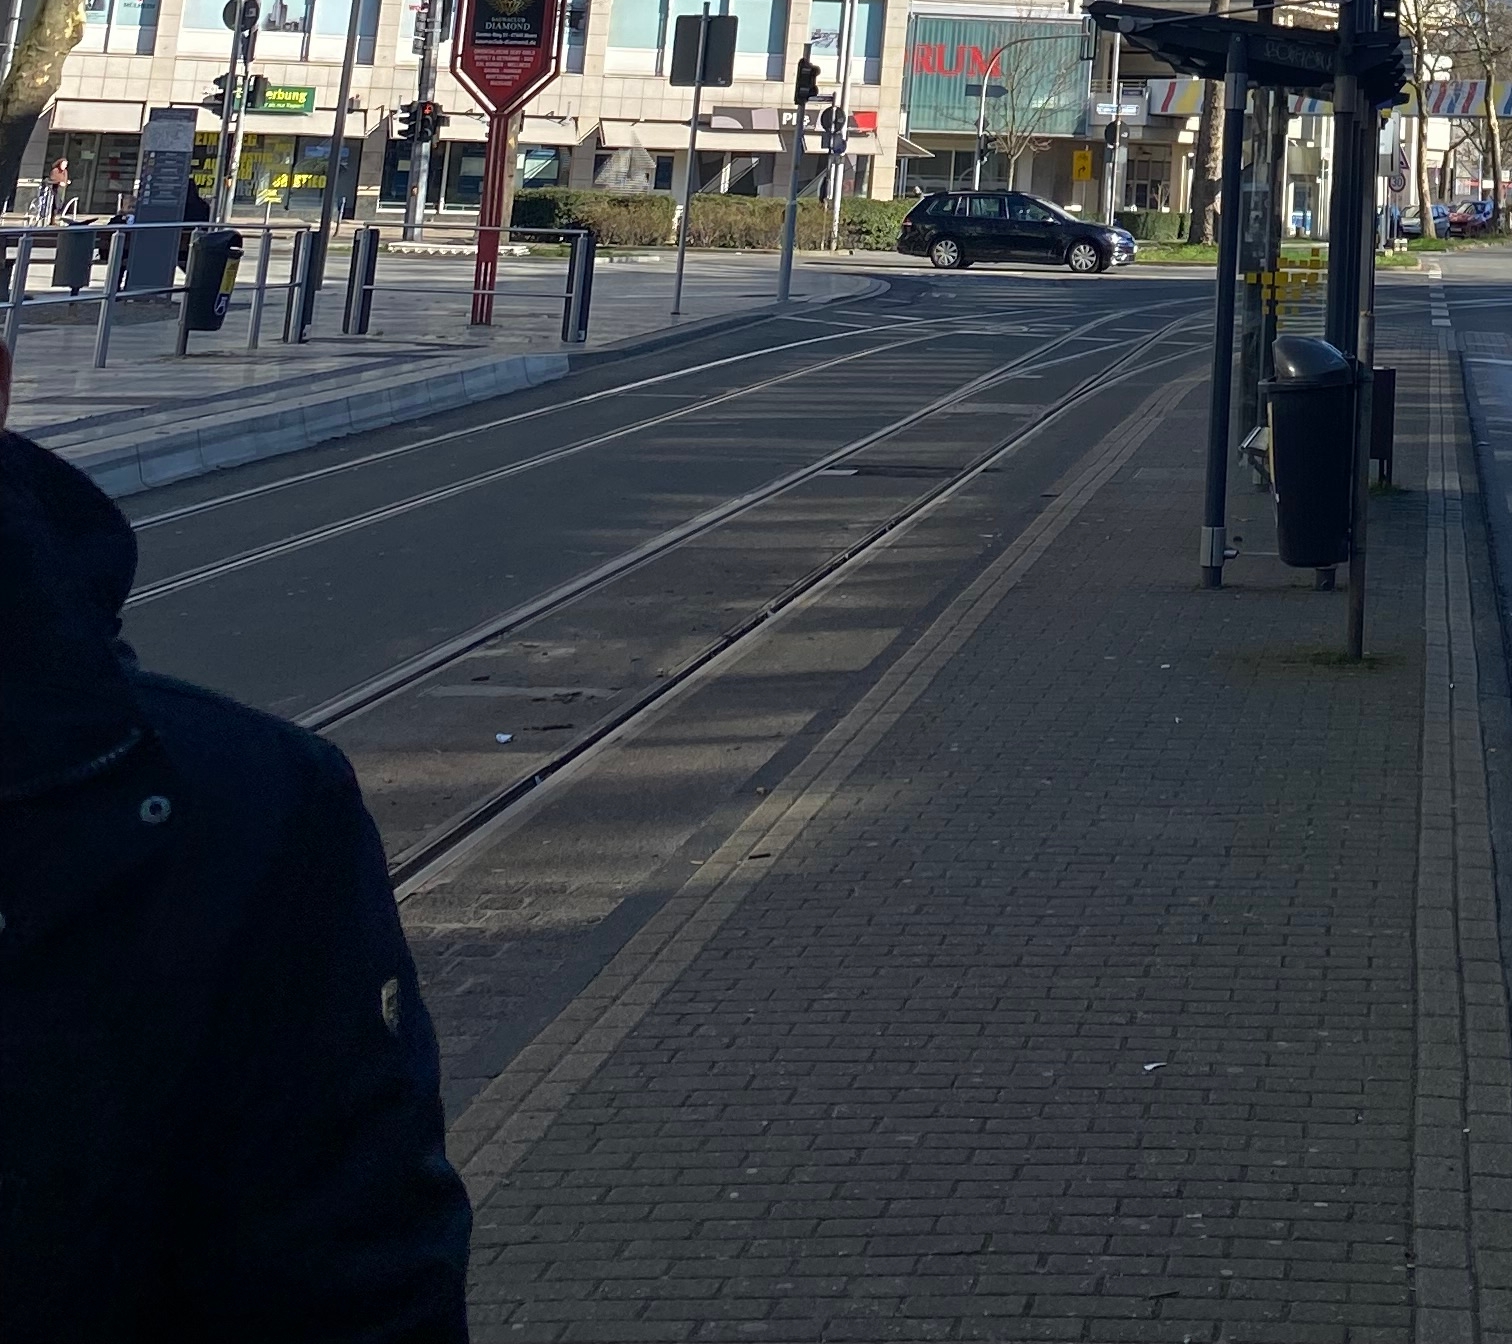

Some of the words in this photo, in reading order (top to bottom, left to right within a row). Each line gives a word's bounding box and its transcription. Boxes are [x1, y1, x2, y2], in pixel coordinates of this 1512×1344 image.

[484, 21, 531, 31] DIAMOND
[904, 43, 1002, 79] RUM
[265, 88, 308, 103] erbung
[1391, 177, 1404, 188] 30
